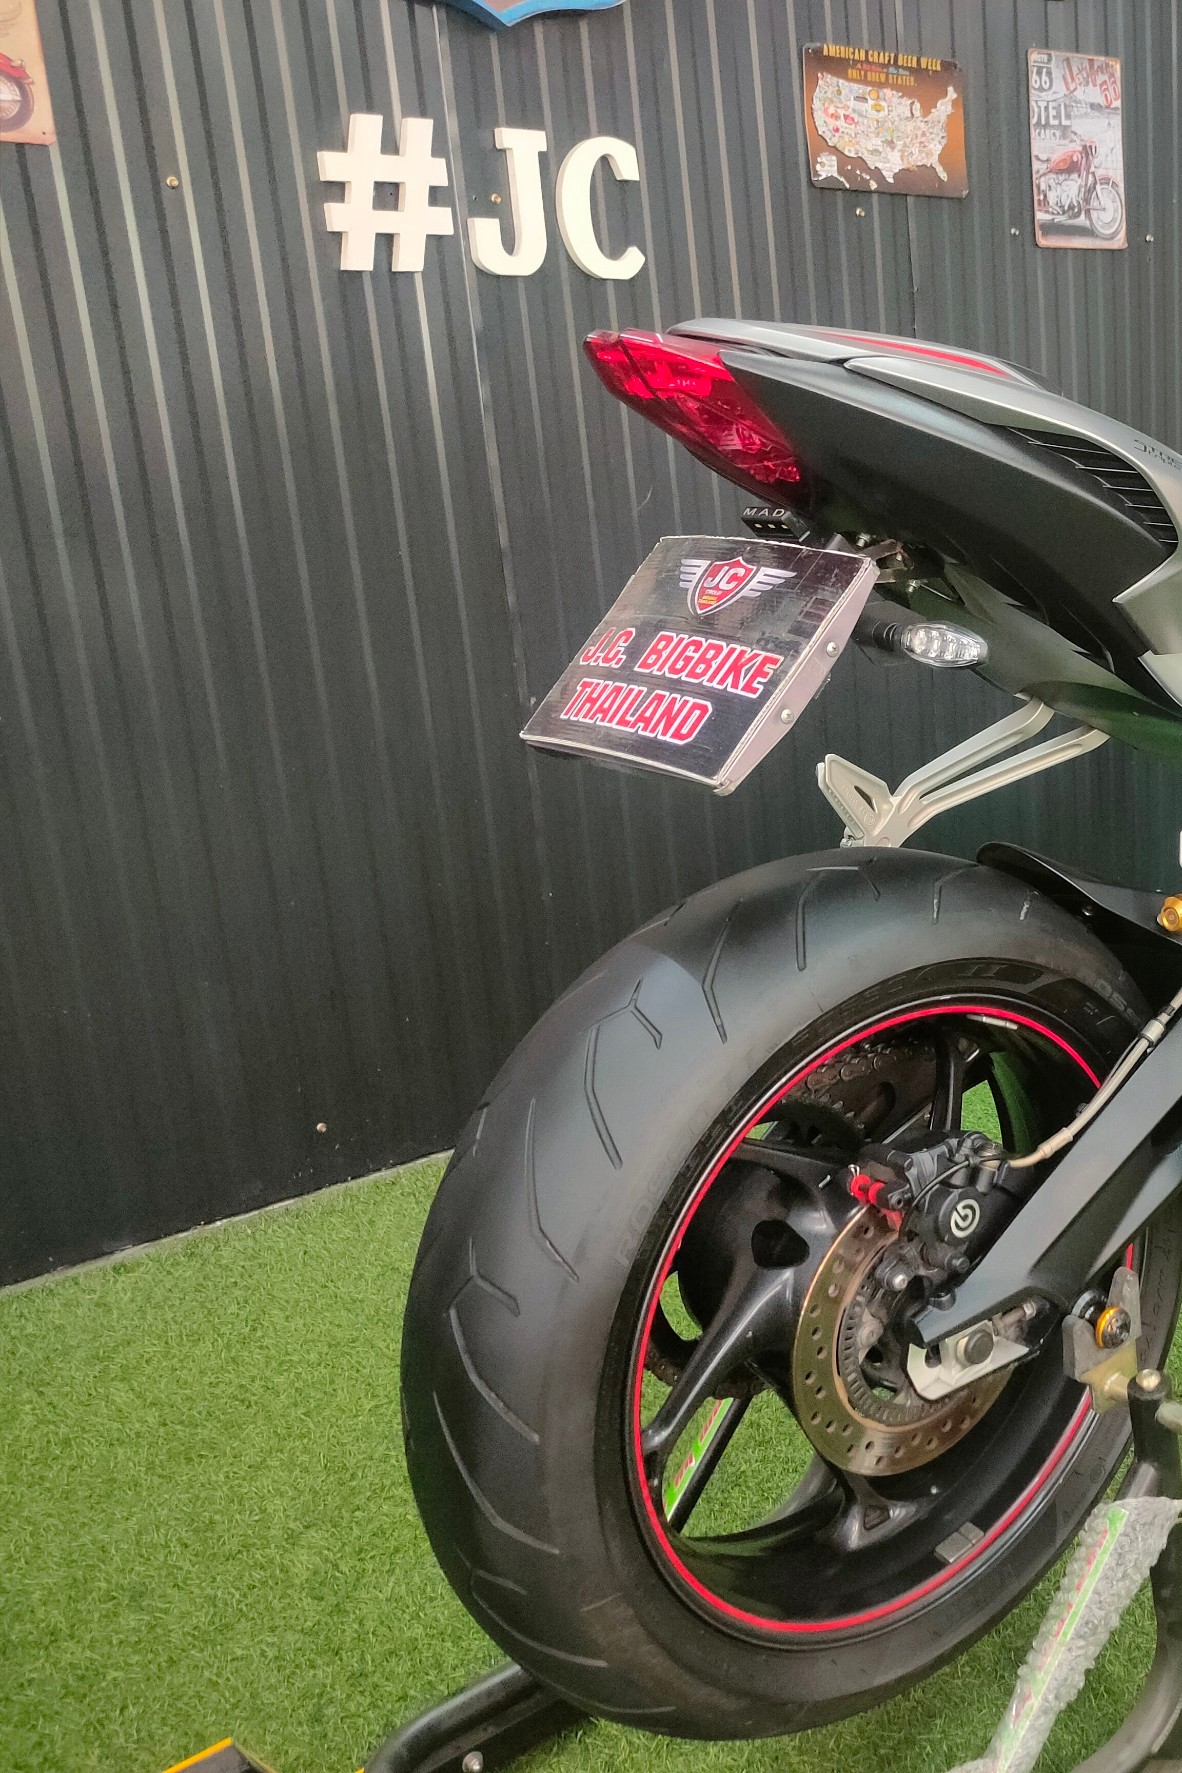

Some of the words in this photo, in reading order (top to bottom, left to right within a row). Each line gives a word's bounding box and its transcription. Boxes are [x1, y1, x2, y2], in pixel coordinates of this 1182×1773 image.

[823, 44, 865, 61] AMERICAN
[868, 50, 895, 65] CRAFT
[898, 53, 918, 69] BEER
[920, 57, 942, 71] WEEK
[1031, 66, 1051, 90] 66
[703, 565, 746, 591] JC
[635, 631, 784, 698] BIGBIKE
[560, 680, 713, 745] THAILAND
